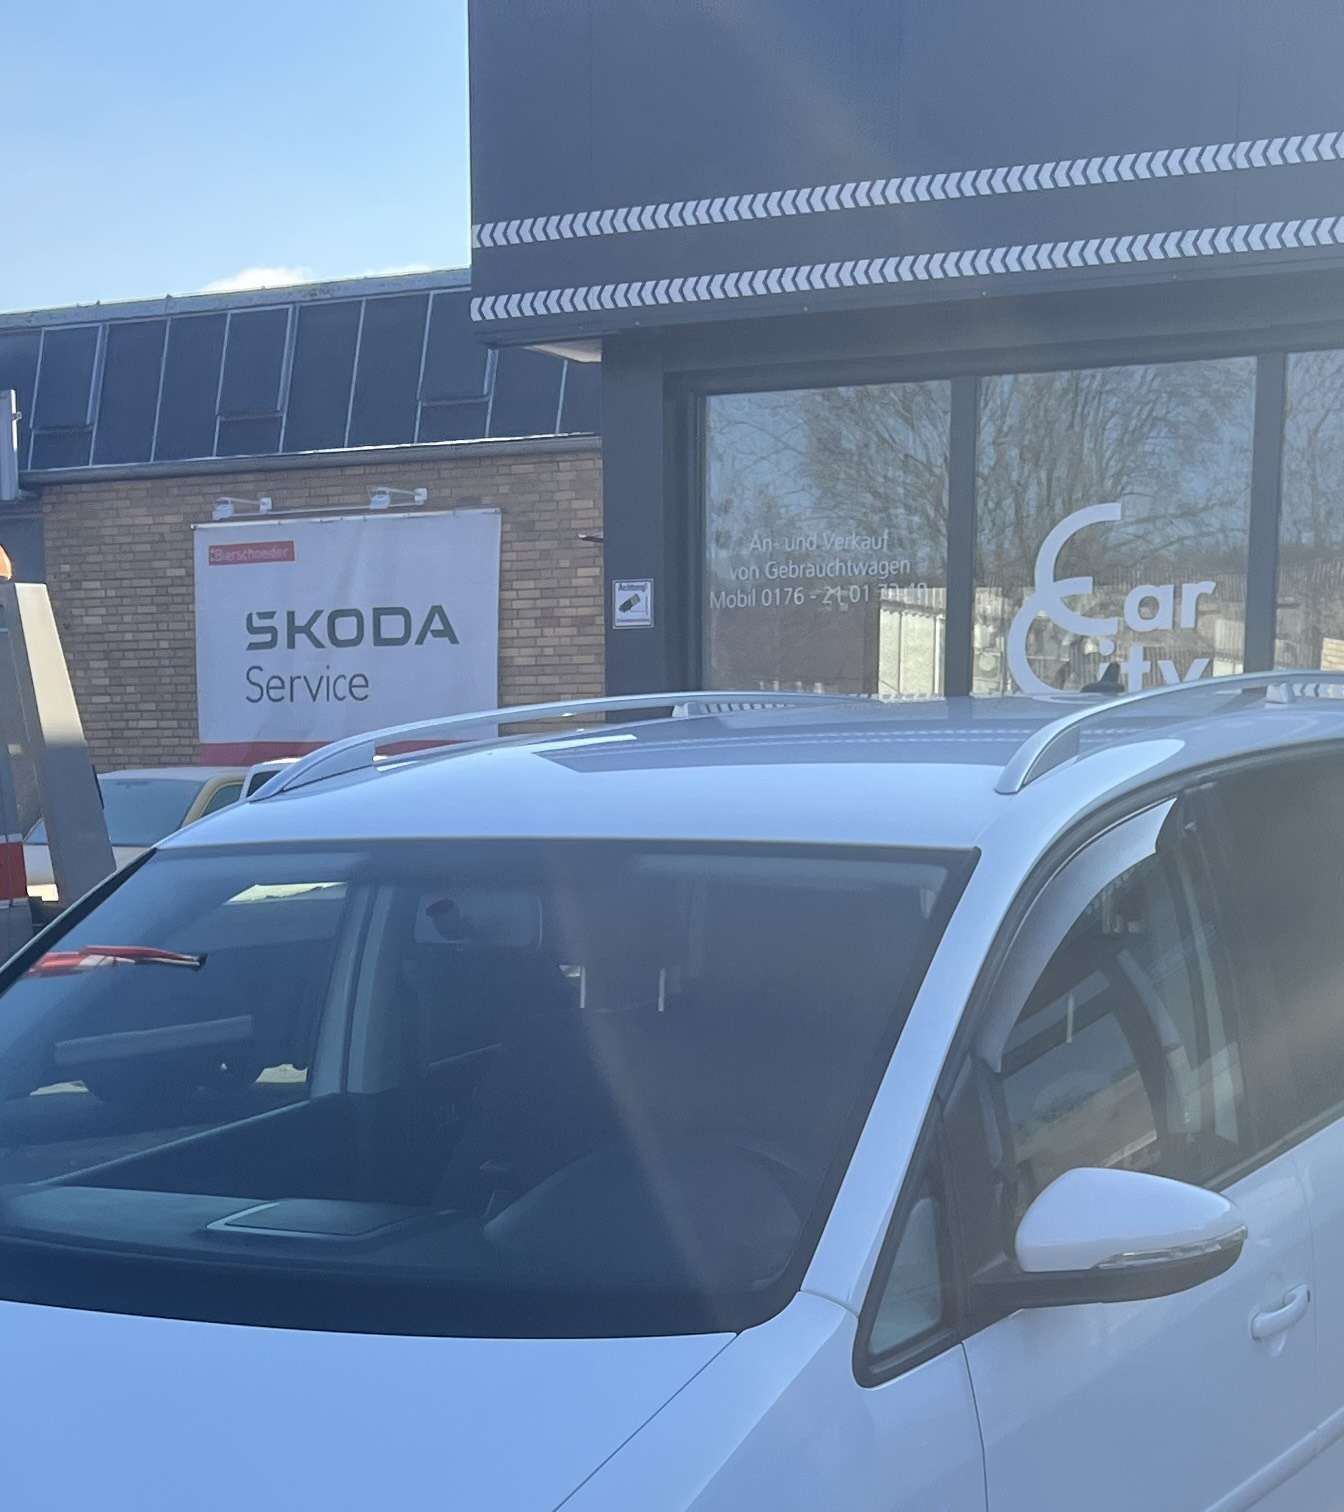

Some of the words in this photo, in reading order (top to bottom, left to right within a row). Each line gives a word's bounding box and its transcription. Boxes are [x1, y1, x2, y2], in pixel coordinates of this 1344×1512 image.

[750, 534, 780, 551] An-
[784, 533, 817, 551] und
[821, 528, 889, 551] Verkauf
[729, 567, 759, 581] von
[764, 559, 911, 579] Gebrauchtwagen
[709, 588, 756, 609] Mobil
[761, 586, 805, 607] 0176
[848, 583, 871, 603] 01
[245, 664, 369, 703] Service
